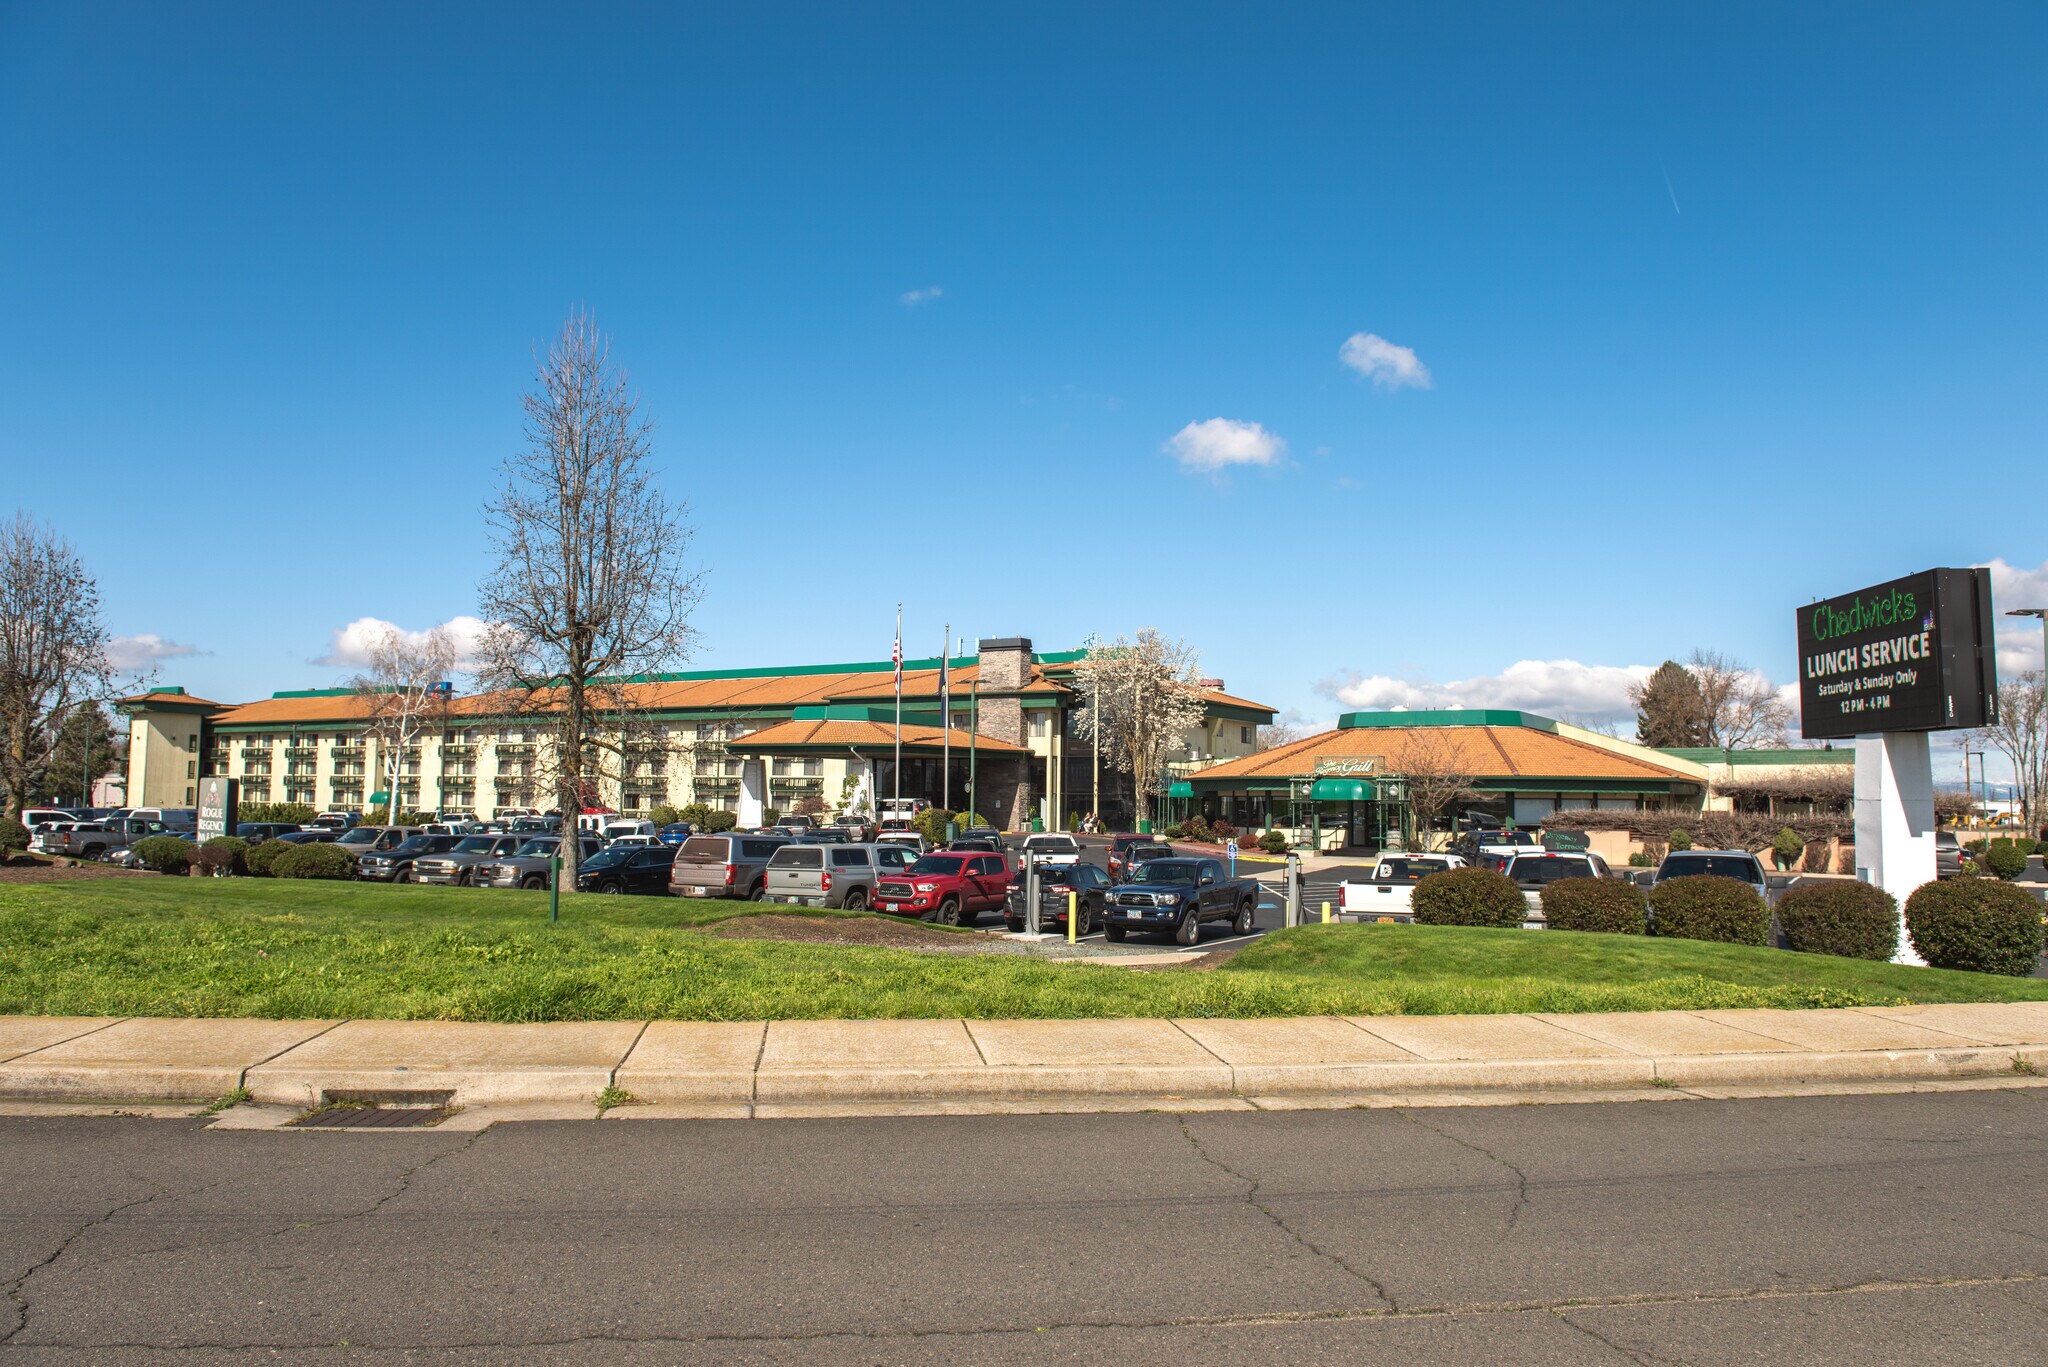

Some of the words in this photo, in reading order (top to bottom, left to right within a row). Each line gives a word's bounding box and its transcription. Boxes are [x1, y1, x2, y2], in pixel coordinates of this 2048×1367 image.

[1813, 587, 1917, 640] Chadwicks
[1807, 647, 1858, 678] LUNCH
[1861, 632, 1931, 668] SERVICE
[1818, 680, 1854, 696] Saturday
[1854, 678, 1861, 691] &
[1862, 673, 1894, 689] Sunday
[1895, 668, 1918, 686] Only
[1840, 700, 1850, 713] 12
[1851, 699, 1864, 712] PM
[1869, 697, 1876, 710] 4
[1876, 695, 1890, 708] PM
[1340, 758, 1374, 776] Grill
